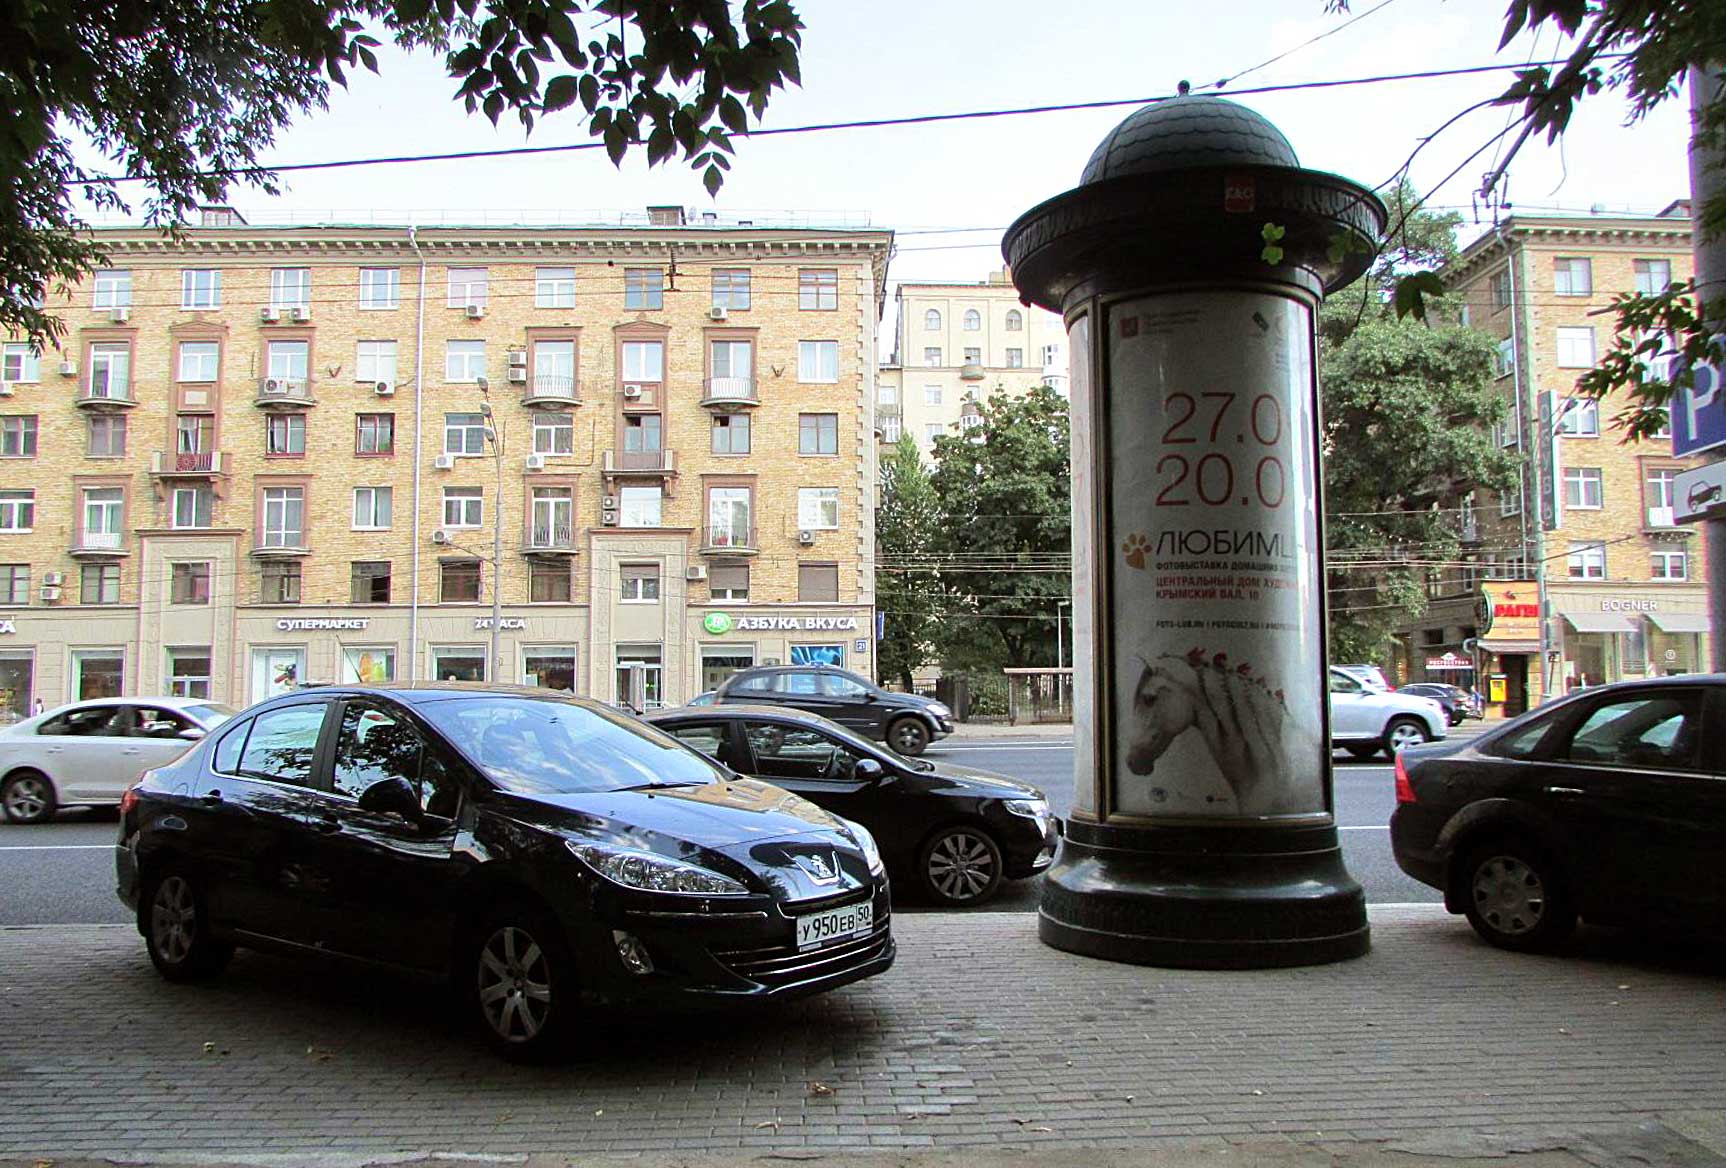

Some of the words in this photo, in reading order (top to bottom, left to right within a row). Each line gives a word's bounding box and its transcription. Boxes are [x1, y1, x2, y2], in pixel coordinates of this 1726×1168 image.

[1685, 360, 1719, 441] P
[1161, 392, 1282, 446] 27.0
[1155, 453, 1285, 509] 20.0
[1155, 529, 1297, 559] ЛЮБИМЦ
[1155, 560, 1229, 571] ФОТОВЫСТАВКА
[1156, 575, 1234, 588] ЦЕНТРАЛЬНЫЙ
[1236, 576, 1261, 589] ДОМ
[1156, 588, 1217, 600] КРЫМСКИЙ
[1601, 601, 1658, 612] BOGNER
[276, 617, 371, 630] СУПЕРМАРКЕТ
[736, 616, 800, 630] АЗБУКА
[805, 616, 859, 630] ВКУСА
[857, 905, 870, 922] 50
